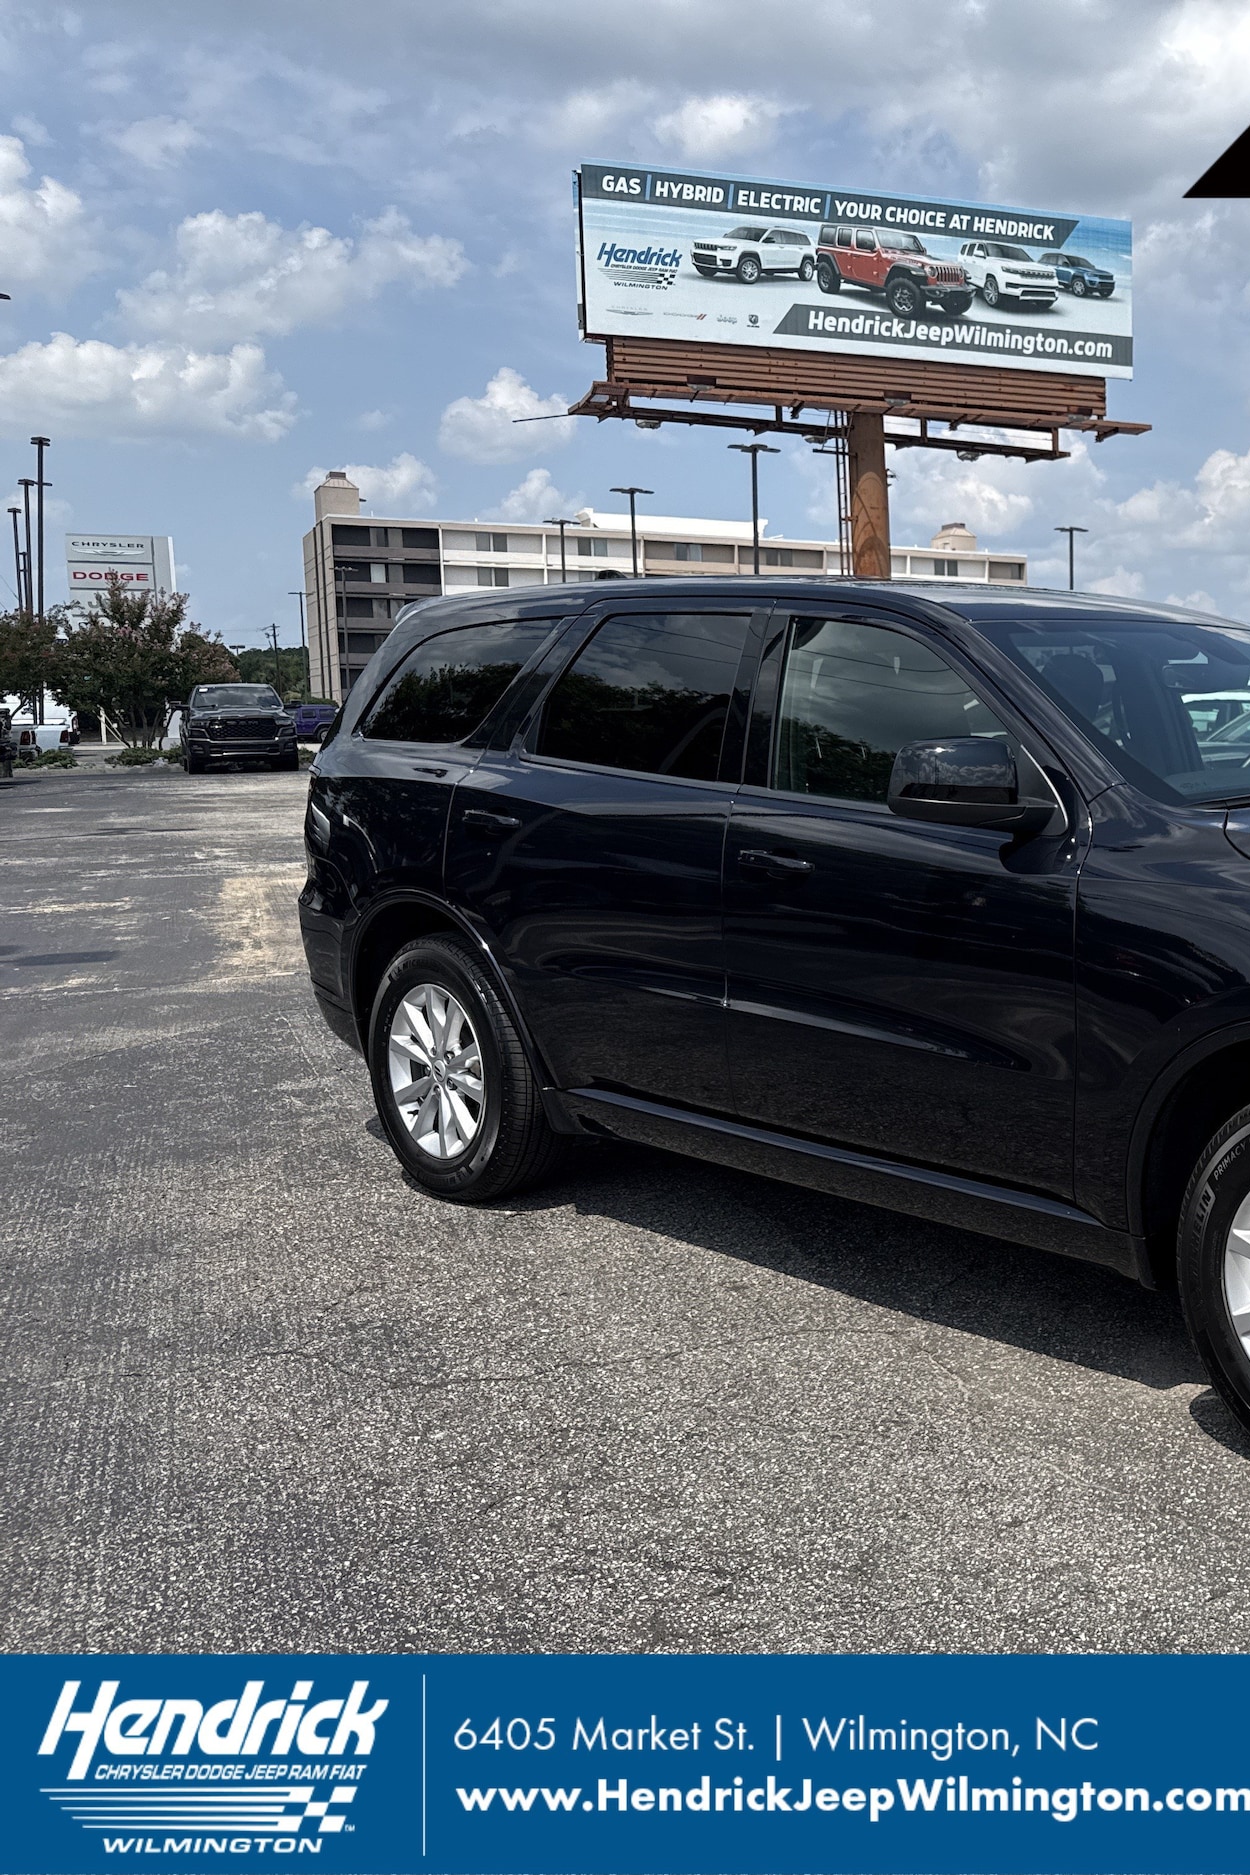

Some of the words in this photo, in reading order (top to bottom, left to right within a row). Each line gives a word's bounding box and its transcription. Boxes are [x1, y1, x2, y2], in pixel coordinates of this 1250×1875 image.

[602, 174, 641, 196] GAS
[655, 180, 725, 204] HYBRID
[737, 189, 822, 214] ELECTRIC
[834, 199, 882, 221] YOUR
[885, 206, 946, 228] CHOICE
[949, 214, 972, 230] AT
[973, 217, 1055, 241] HENDRICK
[597, 242, 683, 267] Hendrick
[613, 281, 669, 291] WILMINGTON
[808, 310, 1113, 359] HendrickJeepWilmington.com
[71, 541, 145, 549] CHRYSLER
[73, 571, 149, 582] DODGE
